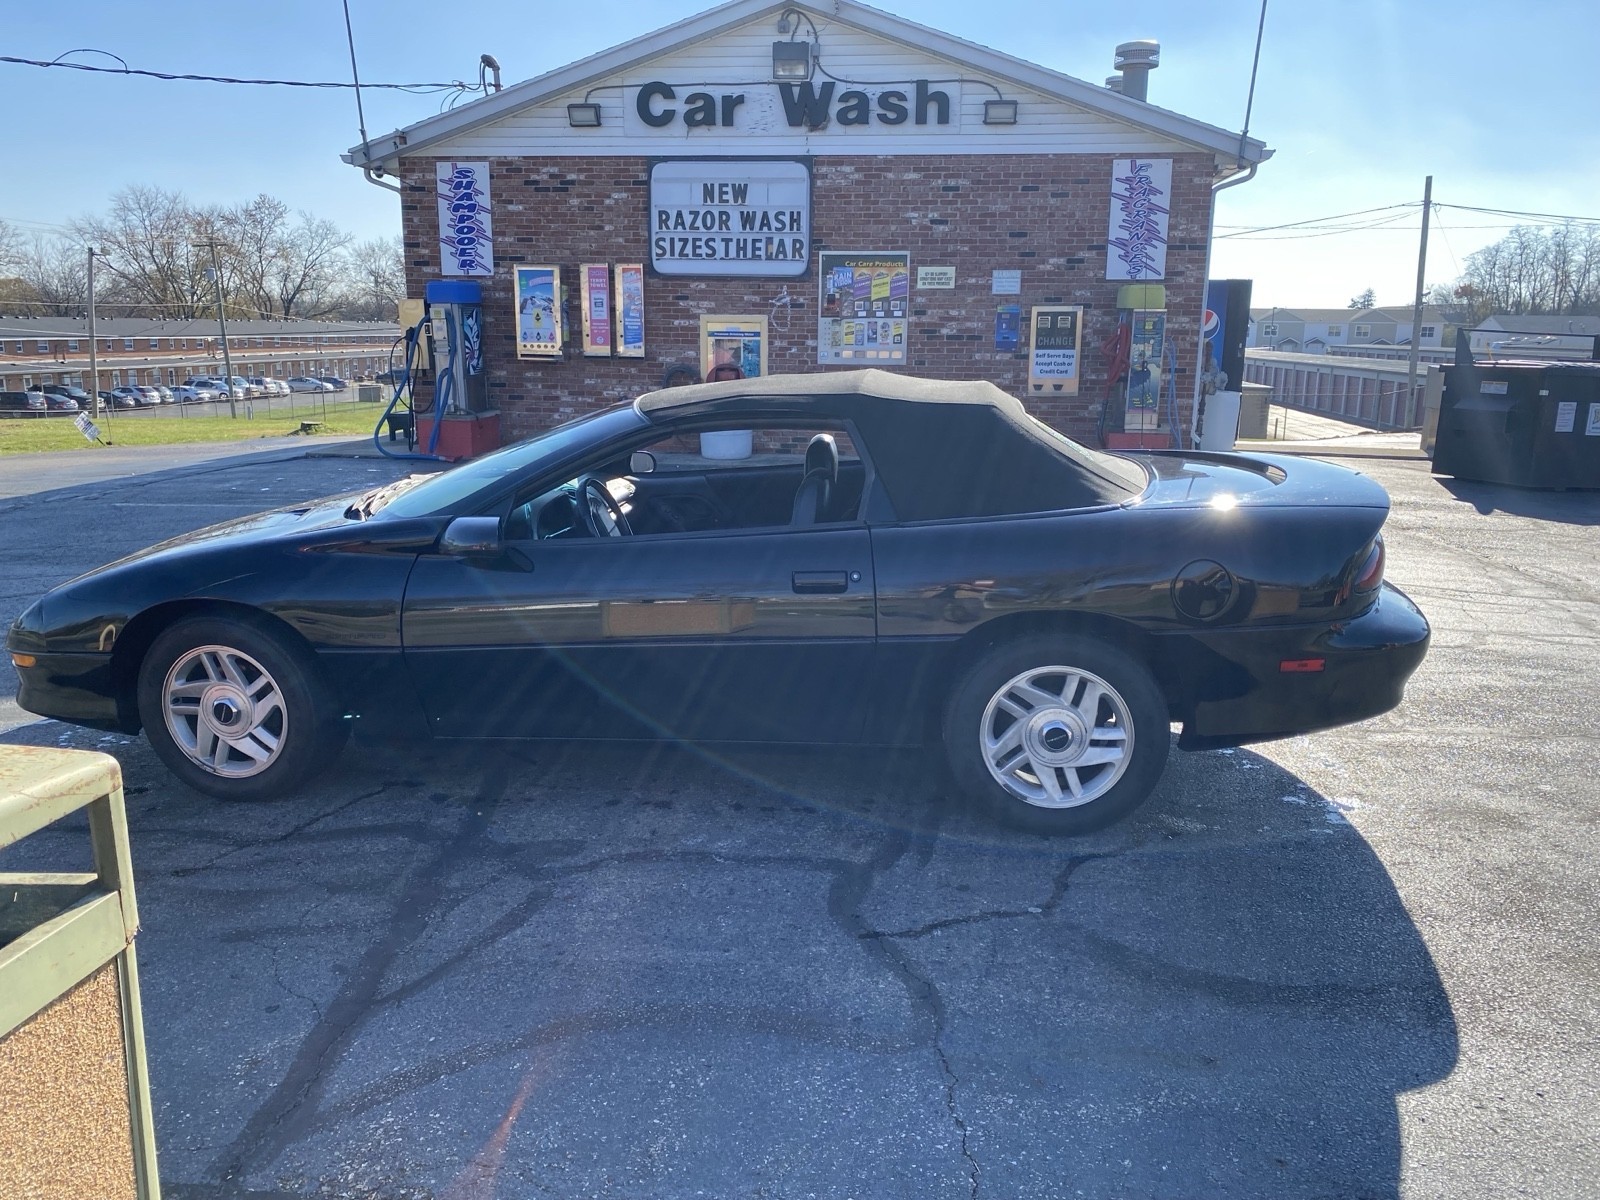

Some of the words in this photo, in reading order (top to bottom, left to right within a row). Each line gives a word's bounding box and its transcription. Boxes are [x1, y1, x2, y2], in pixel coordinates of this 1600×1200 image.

[636, 81, 745, 128] Car
[778, 80, 950, 128] Wash
[703, 183, 748, 204] NEW
[451, 167, 478, 270] SHAMPOOER
[658, 210, 731, 230] RAZOR
[740, 210, 801, 231] WASH
[1127, 163, 1153, 275] FRAGRANCES
[834, 271, 852, 281] RAIN
[1038, 336, 1074, 346] CHANGE
